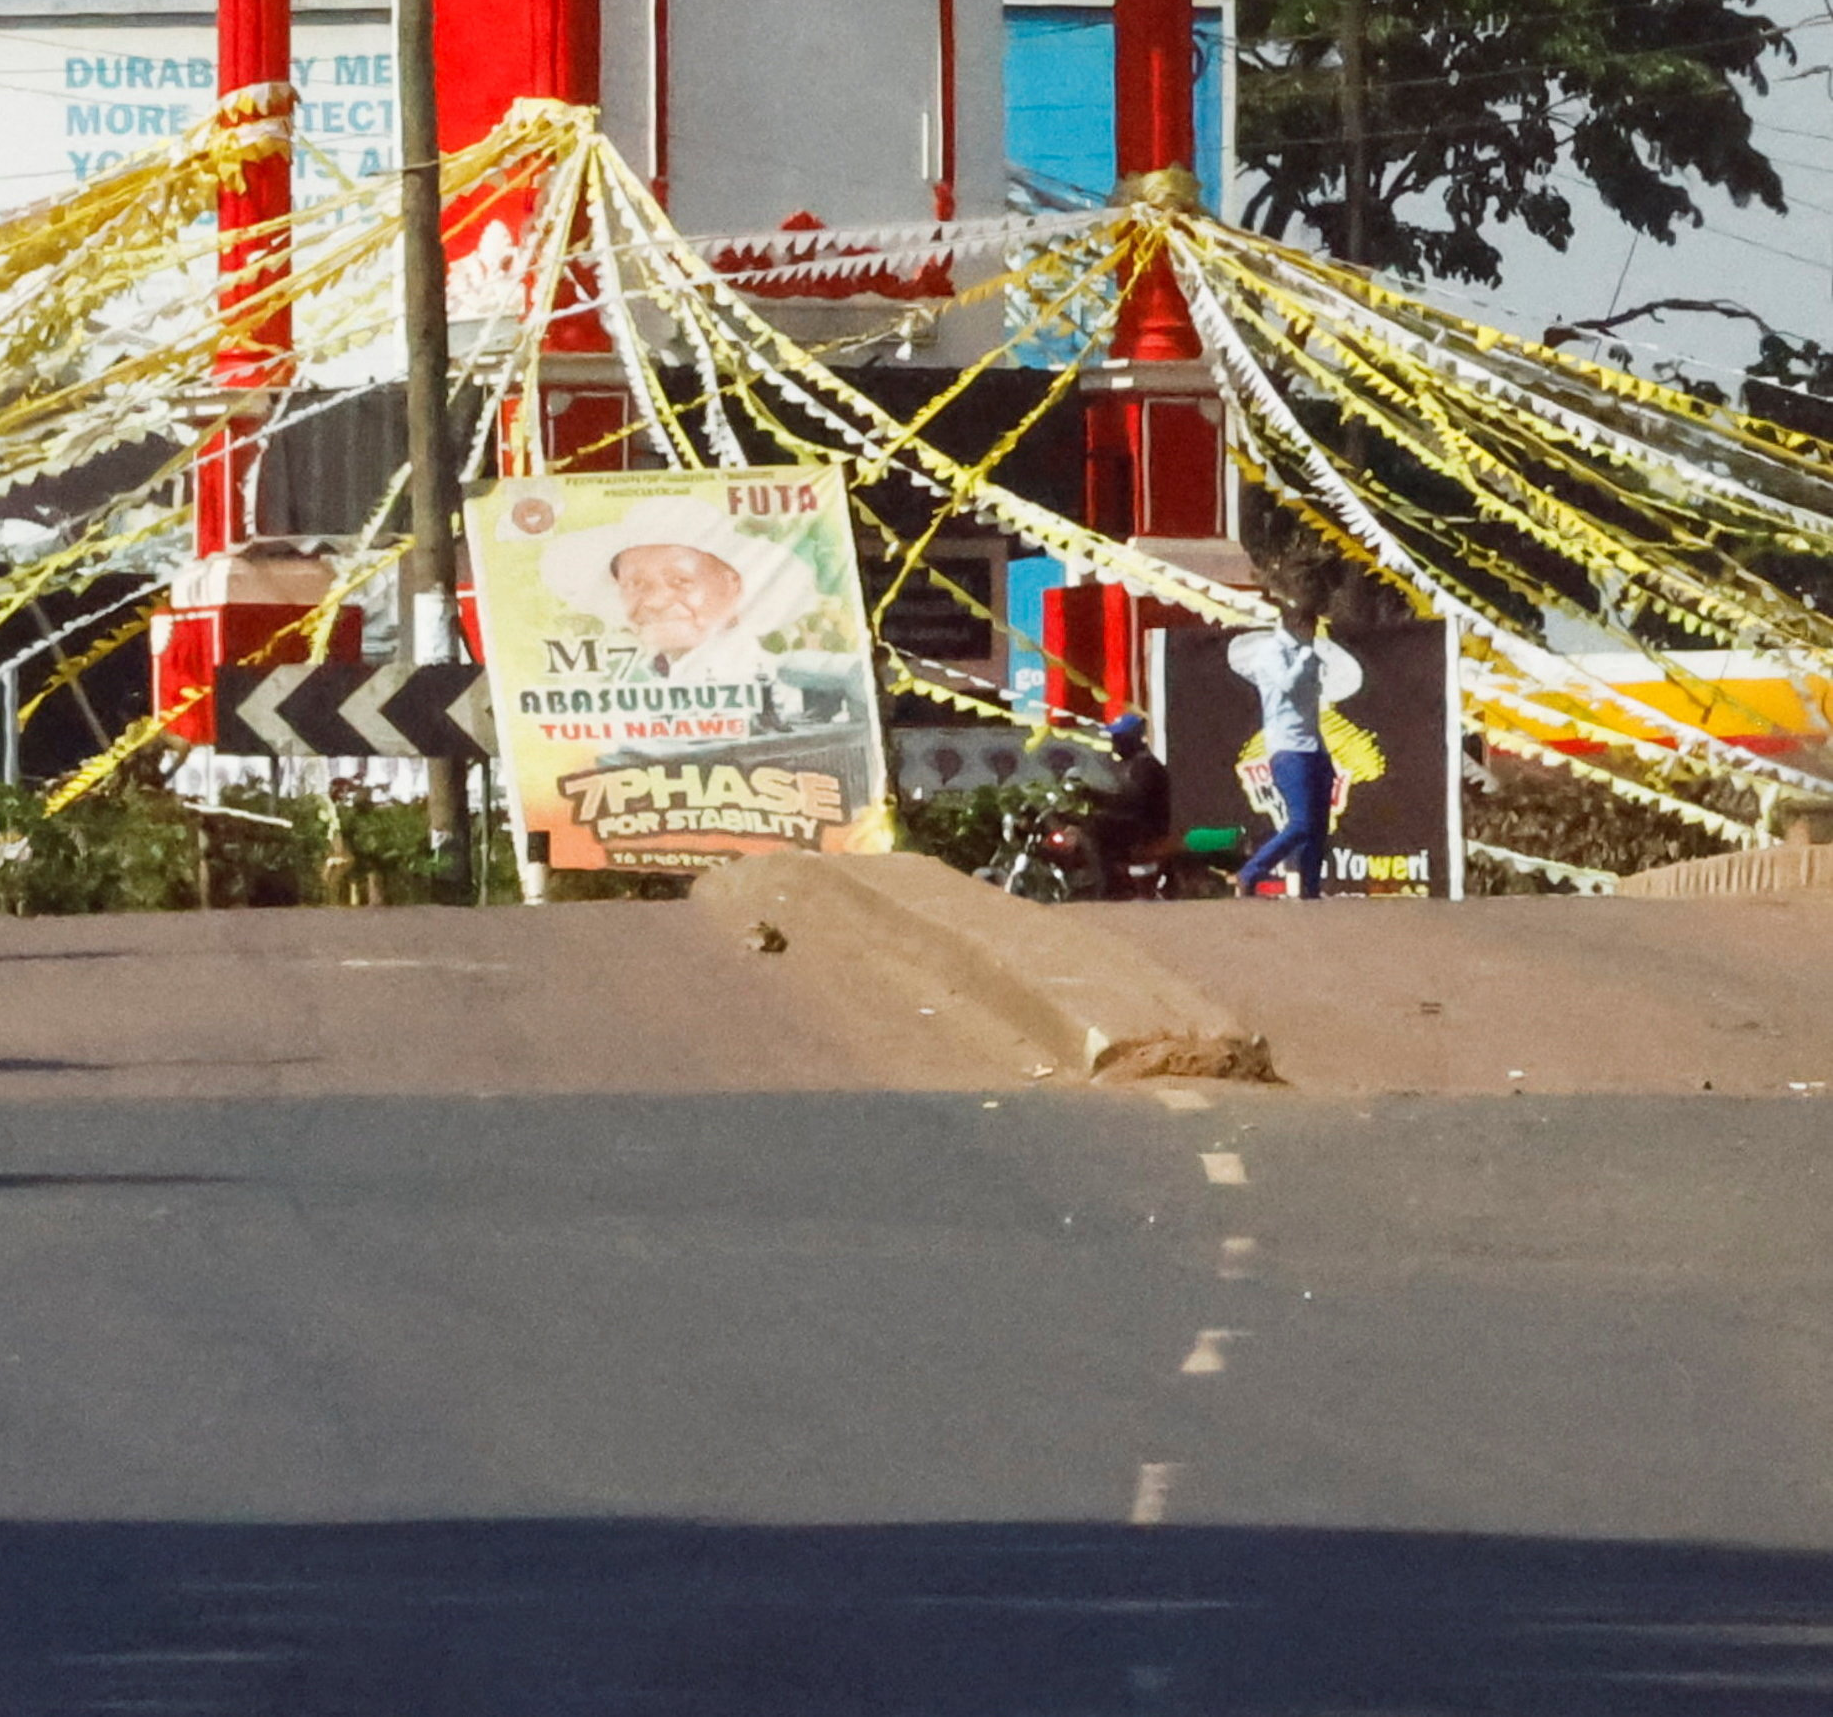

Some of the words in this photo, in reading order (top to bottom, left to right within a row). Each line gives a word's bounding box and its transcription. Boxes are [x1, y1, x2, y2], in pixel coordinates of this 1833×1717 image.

[65, 57, 316, 88] DURABY
[727, 484, 818, 516] FUTA
[543, 638, 638, 681] M7
[520, 684, 756, 714] ABASUUBUZI
[539, 723, 612, 740] TULI
[624, 718, 745, 738] NAAWE
[597, 813, 660, 839] FOR
[666, 809, 818, 840] STABILITY
[1333, 847, 1429, 881] Yoweri
